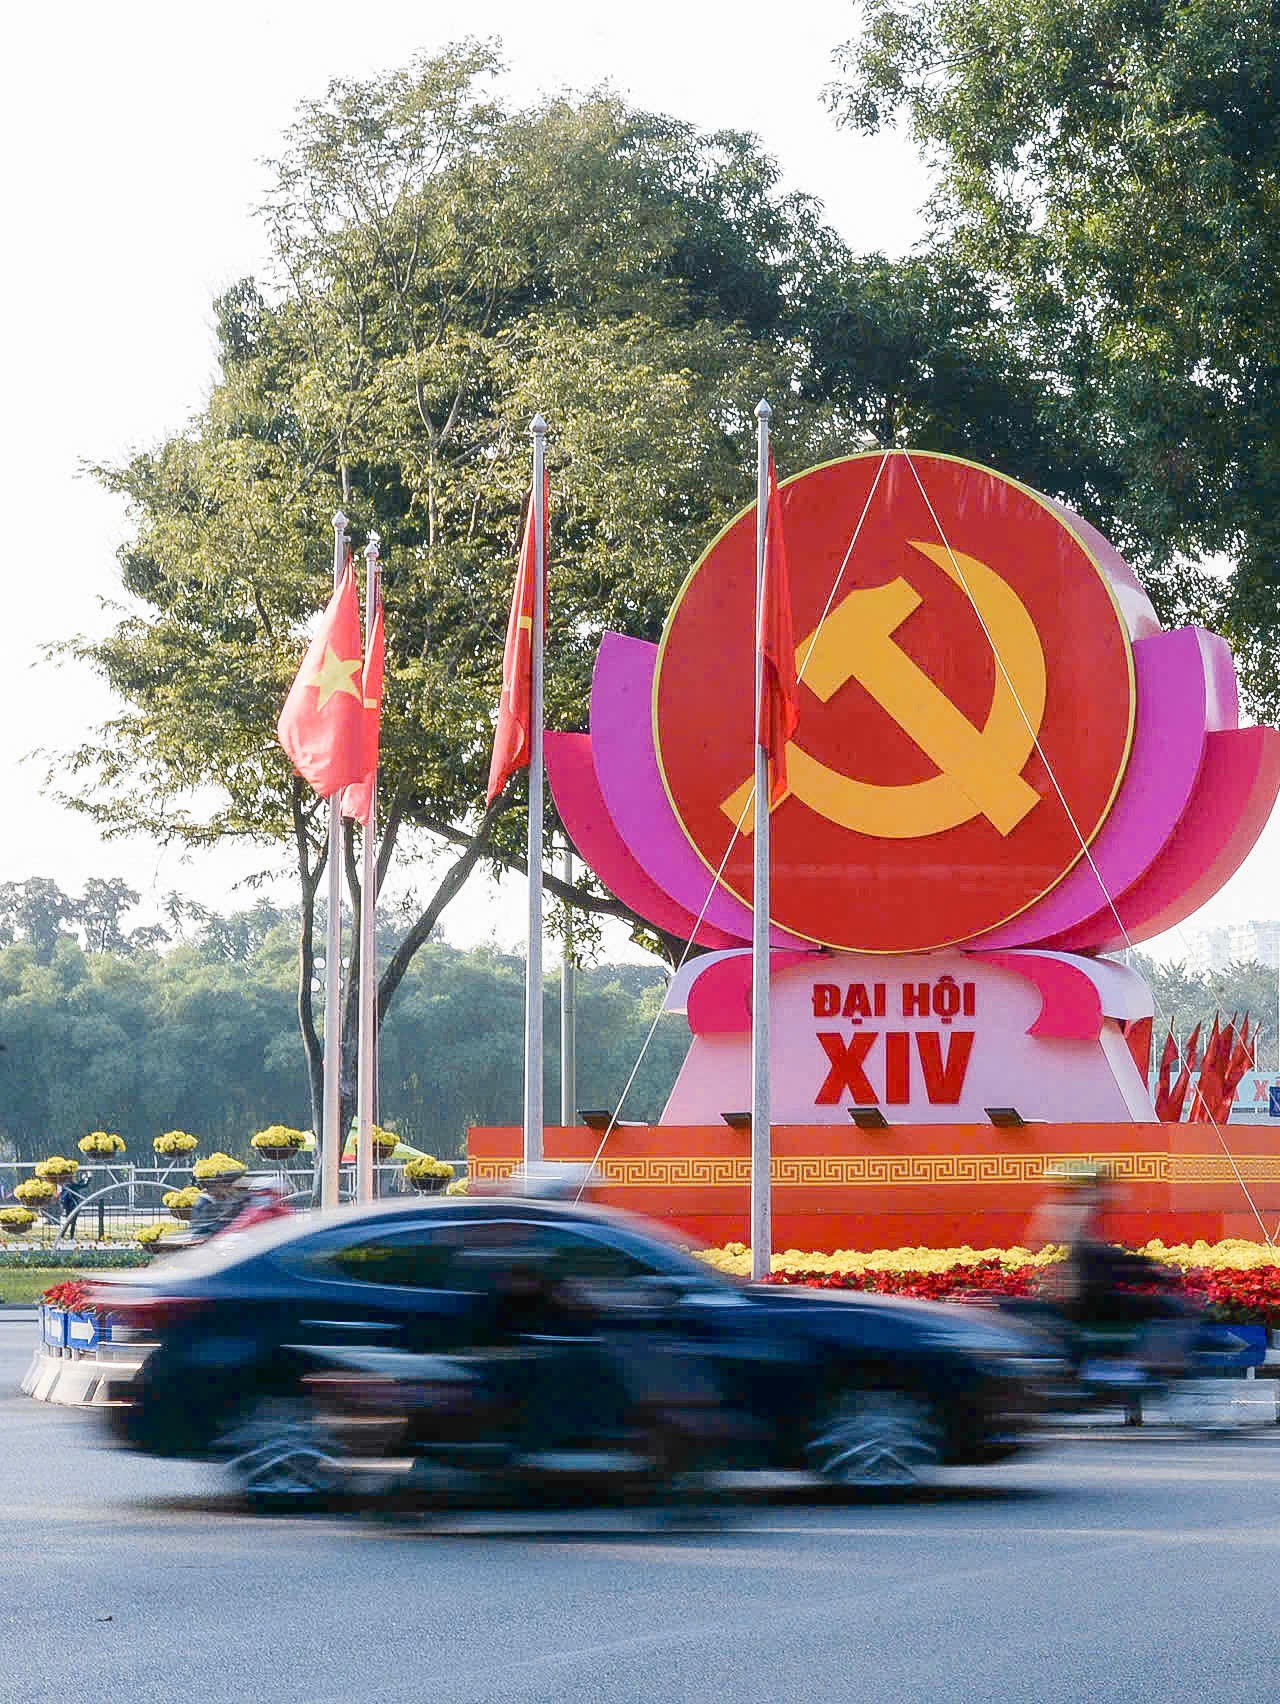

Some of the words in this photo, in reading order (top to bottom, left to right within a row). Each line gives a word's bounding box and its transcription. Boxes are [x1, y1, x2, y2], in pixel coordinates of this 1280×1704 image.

[812, 983, 887, 1024] ĐẠI
[902, 975, 977, 1024] HỘI
[814, 1031, 976, 1105] XIV
